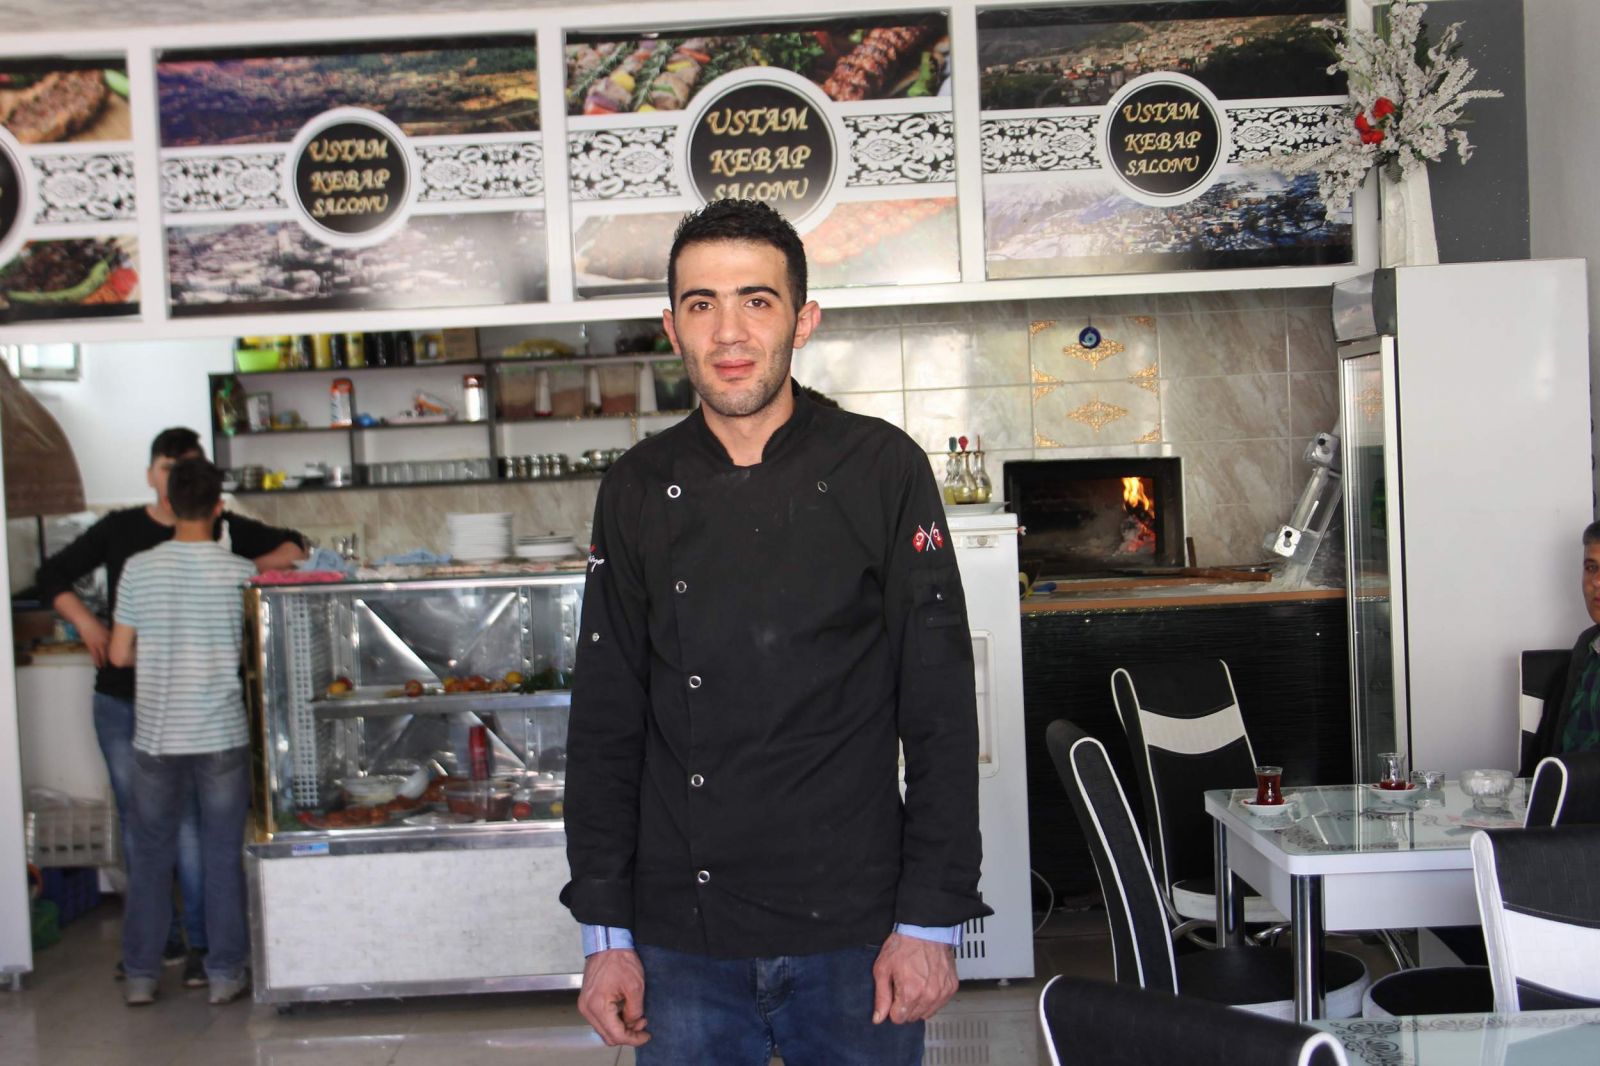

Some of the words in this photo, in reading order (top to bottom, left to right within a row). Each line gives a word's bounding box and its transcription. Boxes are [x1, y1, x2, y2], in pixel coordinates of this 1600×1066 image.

[707, 107, 809, 135] USTAM
[1122, 102, 1200, 123] USTAM
[308, 138, 388, 162] USTAM
[1124, 131, 1202, 154] KEBAP
[709, 145, 812, 177] KEBAP
[1125, 155, 1199, 176] SALONU
[310, 168, 390, 194] KEBAP
[712, 177, 809, 201] SALONU
[312, 193, 389, 217] SALONU
